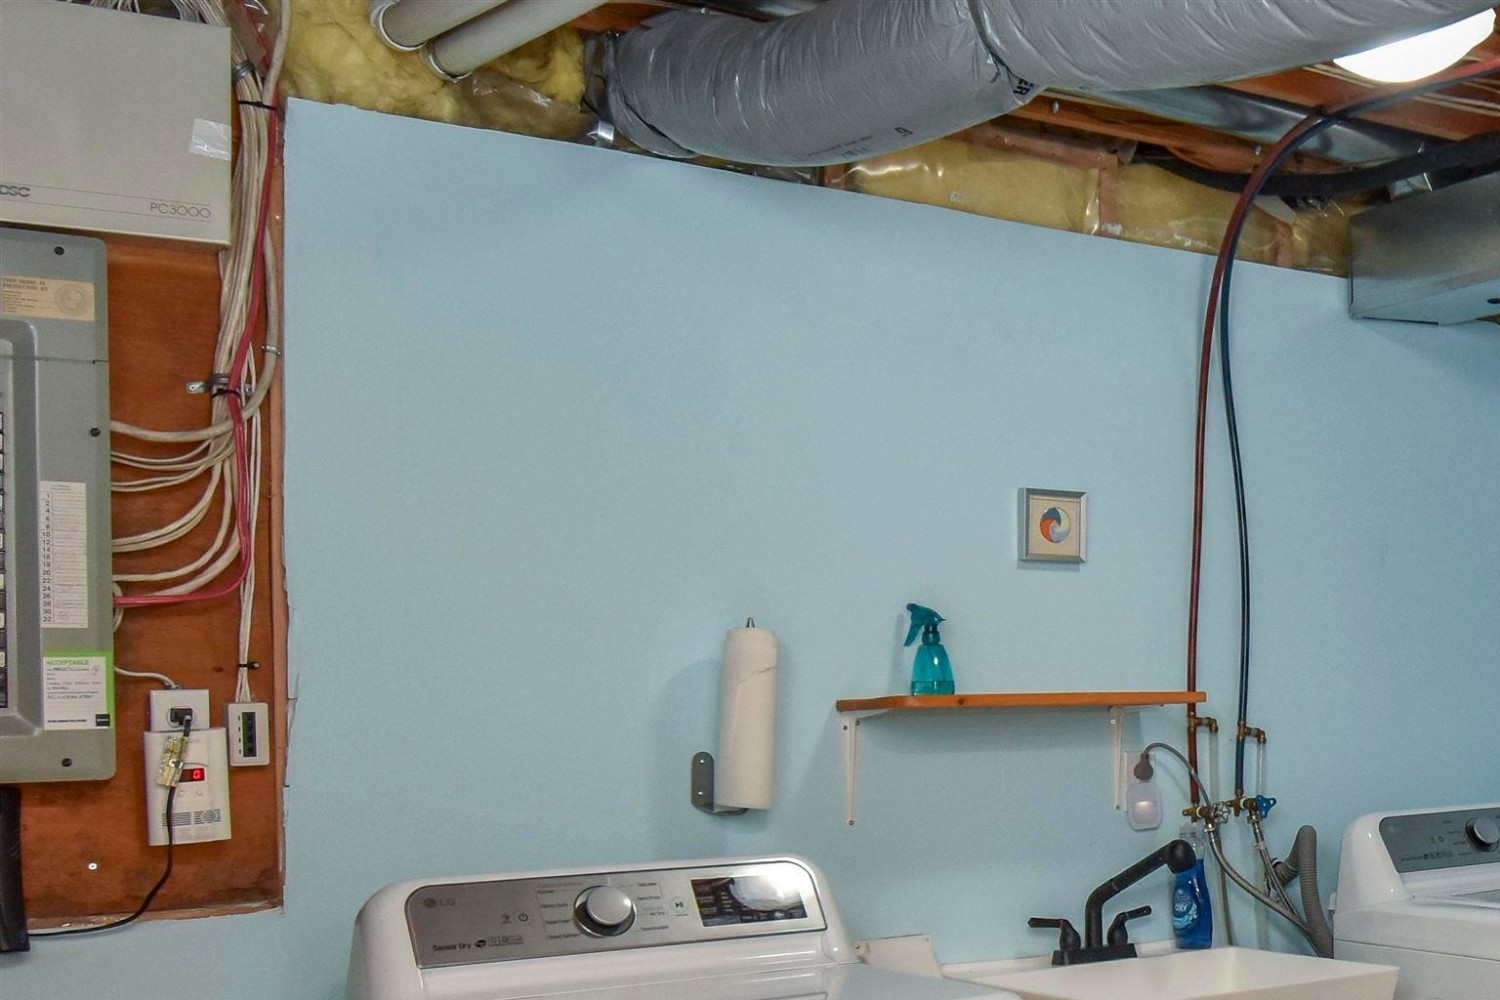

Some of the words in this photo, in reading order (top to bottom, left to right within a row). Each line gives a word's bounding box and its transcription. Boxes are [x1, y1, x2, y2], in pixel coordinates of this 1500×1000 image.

[150, 202, 211, 219] PC3000
[440, 898, 456, 906] LG
[458, 942, 472, 950] Dry
